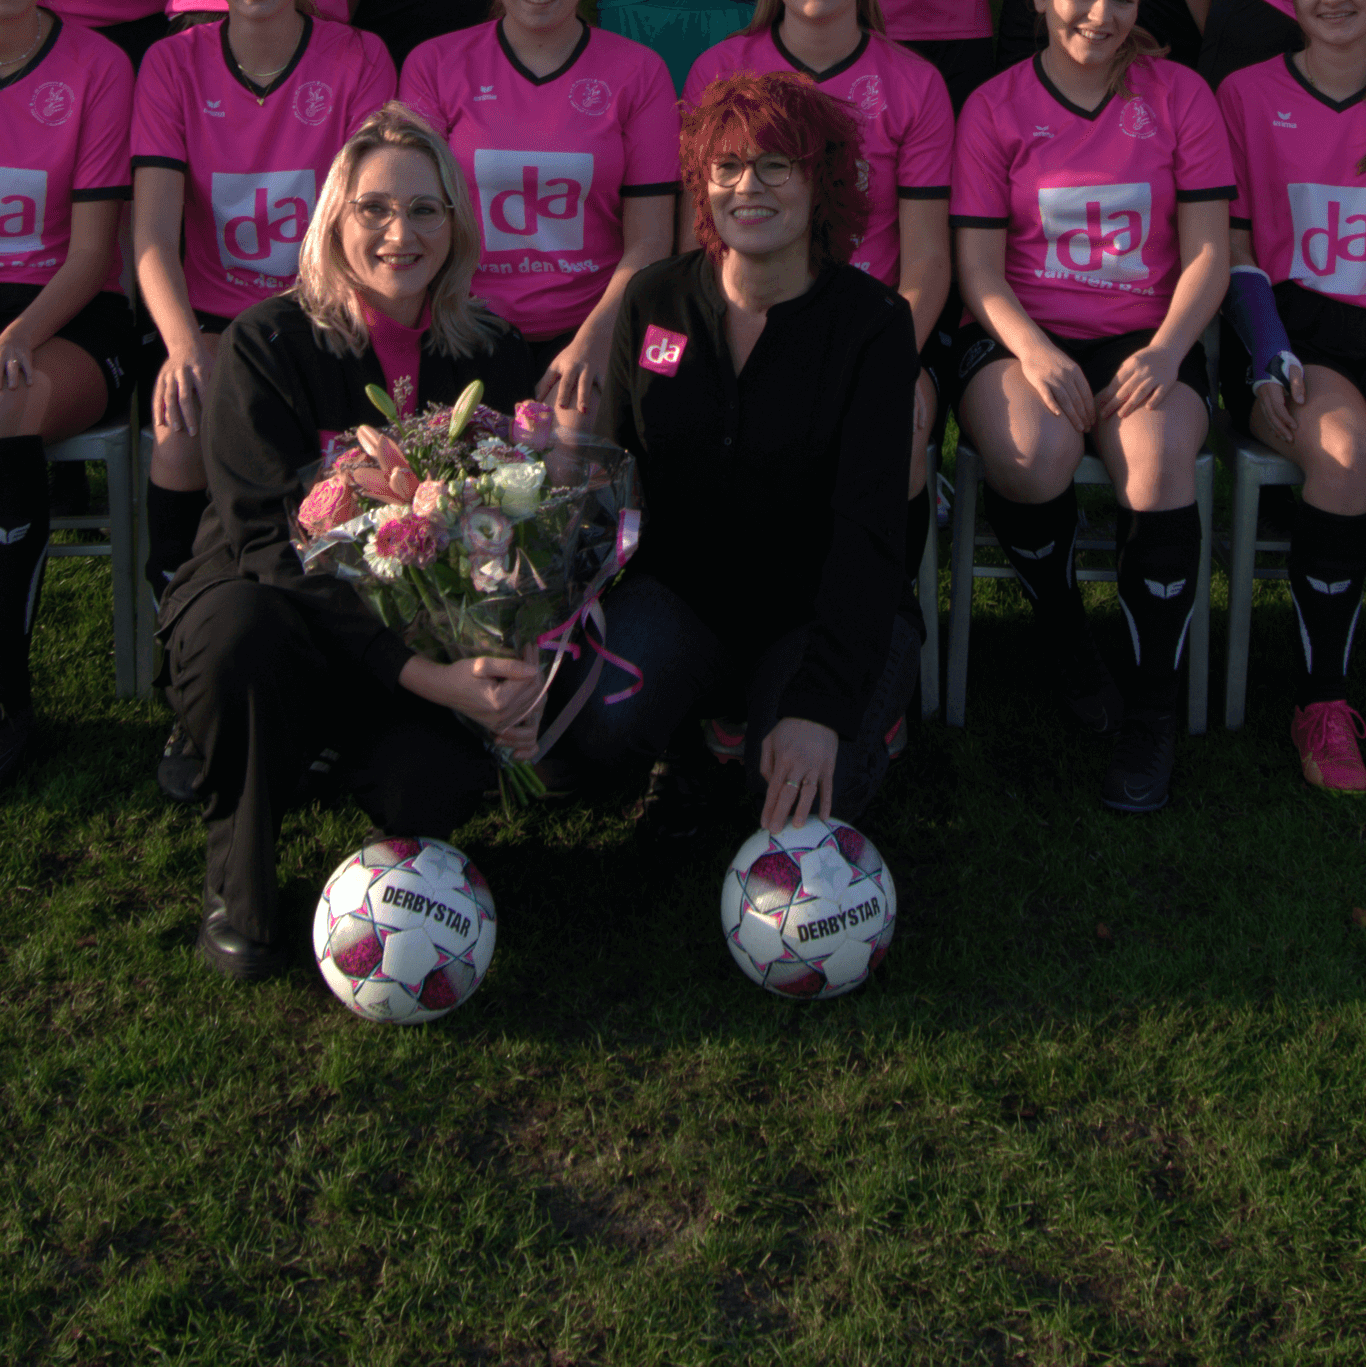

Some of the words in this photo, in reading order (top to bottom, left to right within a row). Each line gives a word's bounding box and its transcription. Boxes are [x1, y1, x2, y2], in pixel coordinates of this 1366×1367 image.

[224, 188, 308, 260] da
[490, 166, 582, 236] da
[1056, 201, 1143, 271] da
[478, 262, 513, 274] van
[518, 257, 555, 274] den
[646, 336, 681, 365] da
[382, 885, 471, 938] DERBYSTAR
[797, 897, 881, 943] DERBYSTAR
